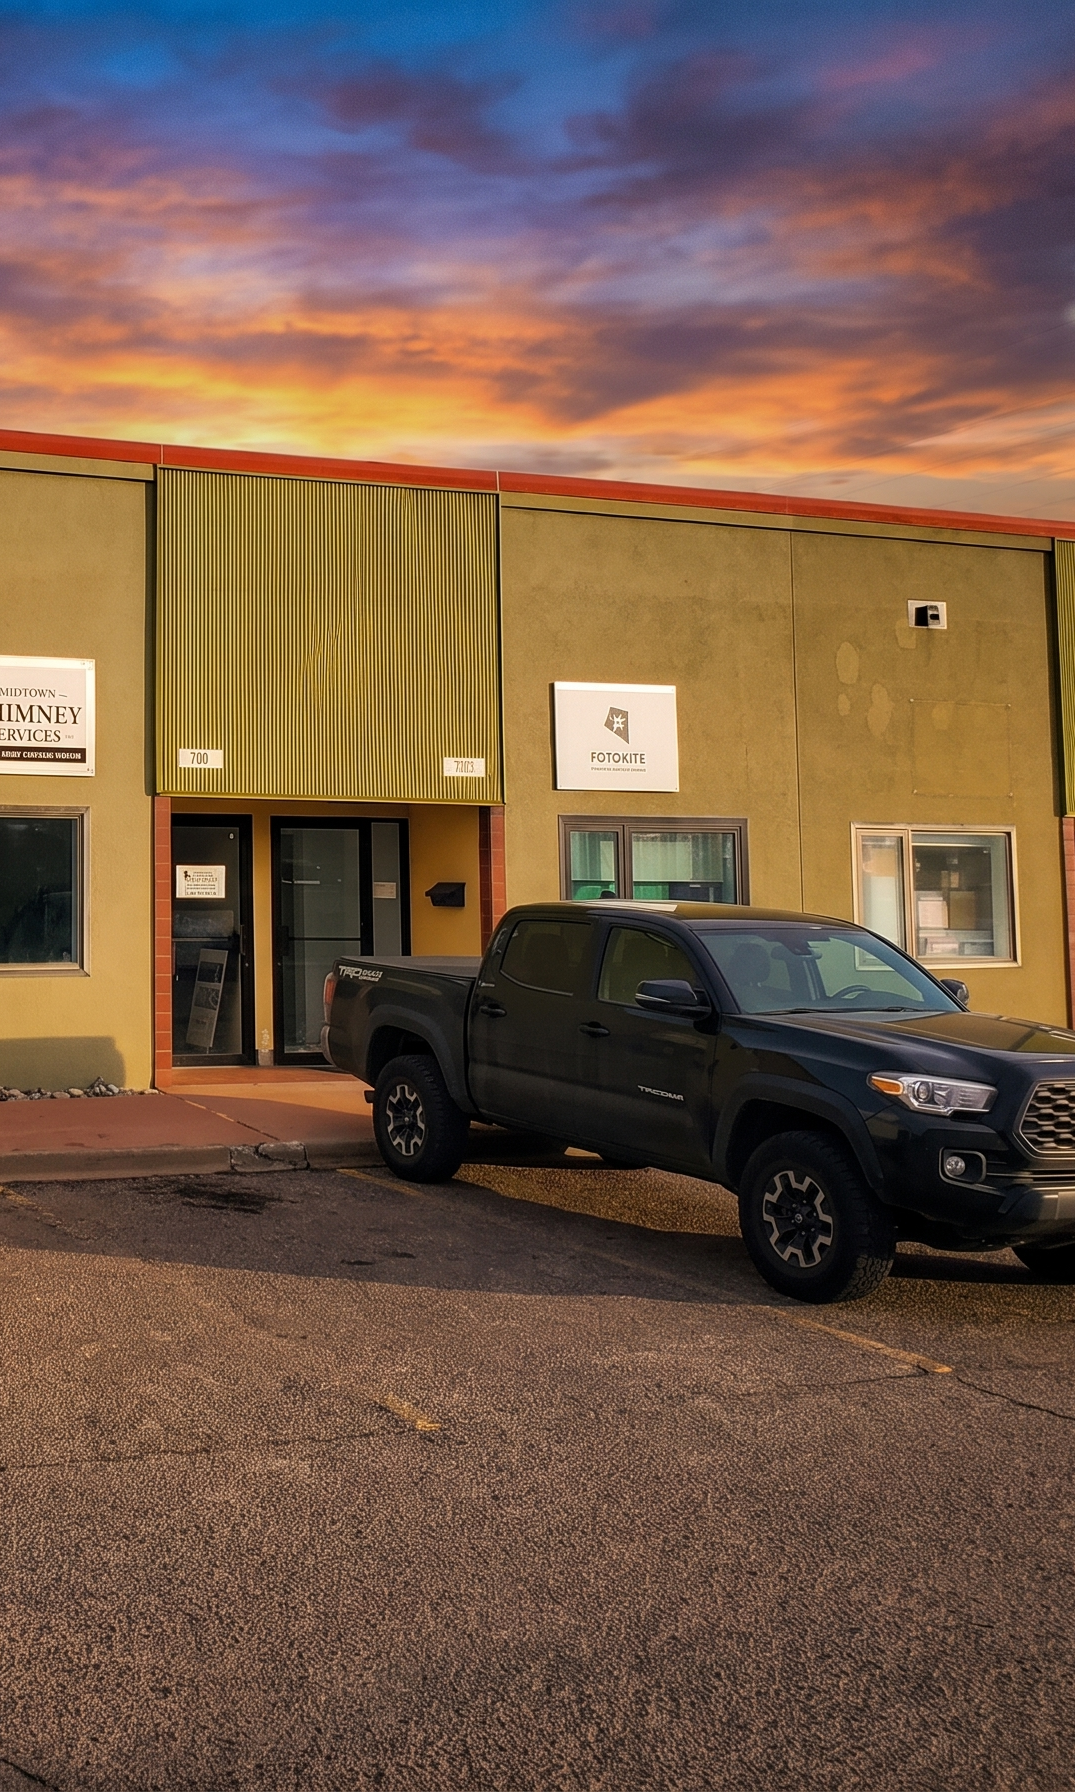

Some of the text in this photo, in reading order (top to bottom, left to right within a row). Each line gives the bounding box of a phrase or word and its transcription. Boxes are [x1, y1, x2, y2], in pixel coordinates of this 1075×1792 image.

[0, 687, 56, 698] MIDTOWN
[190, 751, 209, 765] 700
[591, 752, 646, 764] FOTOKITE
